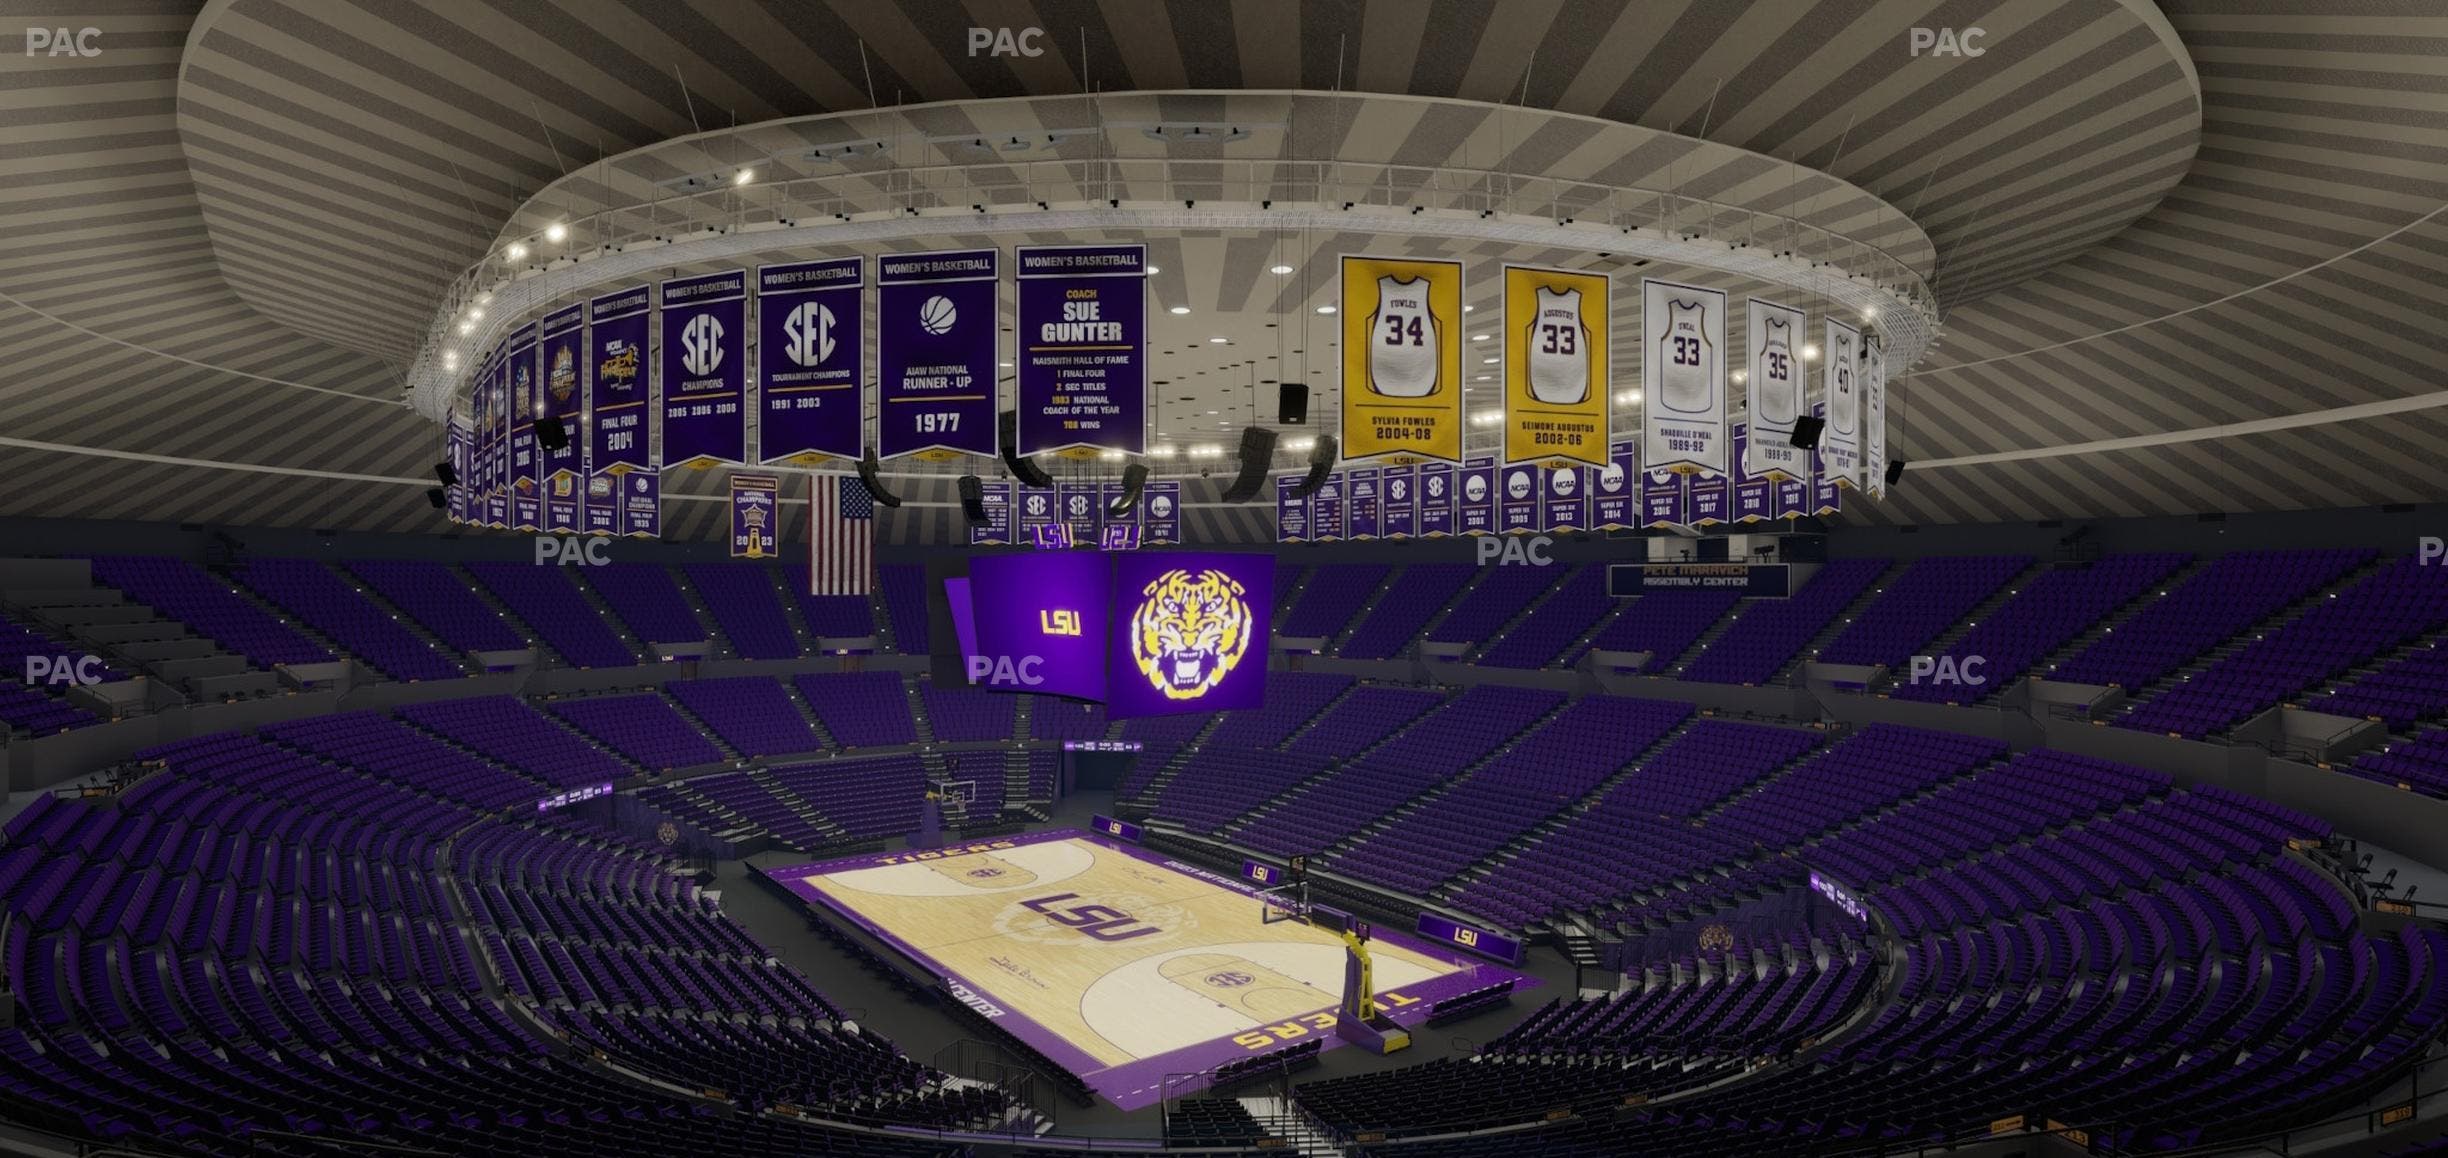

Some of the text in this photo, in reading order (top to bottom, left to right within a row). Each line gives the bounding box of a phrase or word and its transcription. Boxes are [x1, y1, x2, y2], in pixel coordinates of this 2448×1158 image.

[885, 259, 991, 275] WOMEN'S BASKETBALL
[1025, 255, 1138, 267] WOMEN'S BASKETBALL
[764, 267, 857, 285] WOMEN'S BASKETBALL
[665, 280, 741, 299] WOMEN'S BASKETBALL
[1066, 289, 1097, 298] COACH
[1390, 299, 1417, 309] FOWLES
[1063, 301, 1099, 321] SUE
[783, 301, 836, 367] SEC
[1041, 322, 1122, 342] GUNTER
[1385, 315, 1424, 346] 34
[681, 314, 724, 376] SEC
[1542, 324, 1575, 355] 33
[1673, 336, 1700, 366] 33
[1073, 357, 1093, 365] HALL
[1094, 356, 1105, 364] OF
[1106, 356, 1129, 364] FAME
[1769, 352, 1787, 380] 35
[928, 365, 969, 375] NATIONAL
[1063, 370, 1084, 378] FINAL
[682, 379, 723, 391] CHAMPIONS
[903, 377, 948, 390] RUNNER
[956, 376, 972, 388] UP
[1065, 383, 1080, 391] SEC
[1082, 383, 1106, 391] TITLES
[771, 397, 821, 410] 1991 2003
[1043, 406, 1120, 415] COACH OF THE YEAR
[620, 415, 638, 428] FOUR
[915, 413, 960, 432] 1977
[1080, 420, 1101, 429] WINS
[1371, 416, 1435, 427] SYLVIA FOWLES
[1522, 421, 1594, 433] SEIMONE AUGUSTUS
[1376, 427, 1432, 440] 2004-08
[1535, 433, 1582, 445] 2002-06
[608, 431, 633, 451] 2004
[1555, 481, 1576, 489] NCAA
[1604, 477, 1623, 485] NCAA
[1511, 484, 1530, 492] NCAA
[736, 497, 772, 505] CHAMPIONS
[736, 536, 772, 546] 20 23
[1643, 577, 1749, 586] ASSEMBLY CENTER
[1040, 610, 1082, 636] LSU
[1109, 821, 1122, 835] LSU
[875, 841, 1015, 865] TIGERS
[1252, 865, 1268, 881] LSU
[1019, 893, 1163, 942] LSU
[1454, 926, 1478, 947] LSU
[1233, 992, 1421, 1050] TIERS
